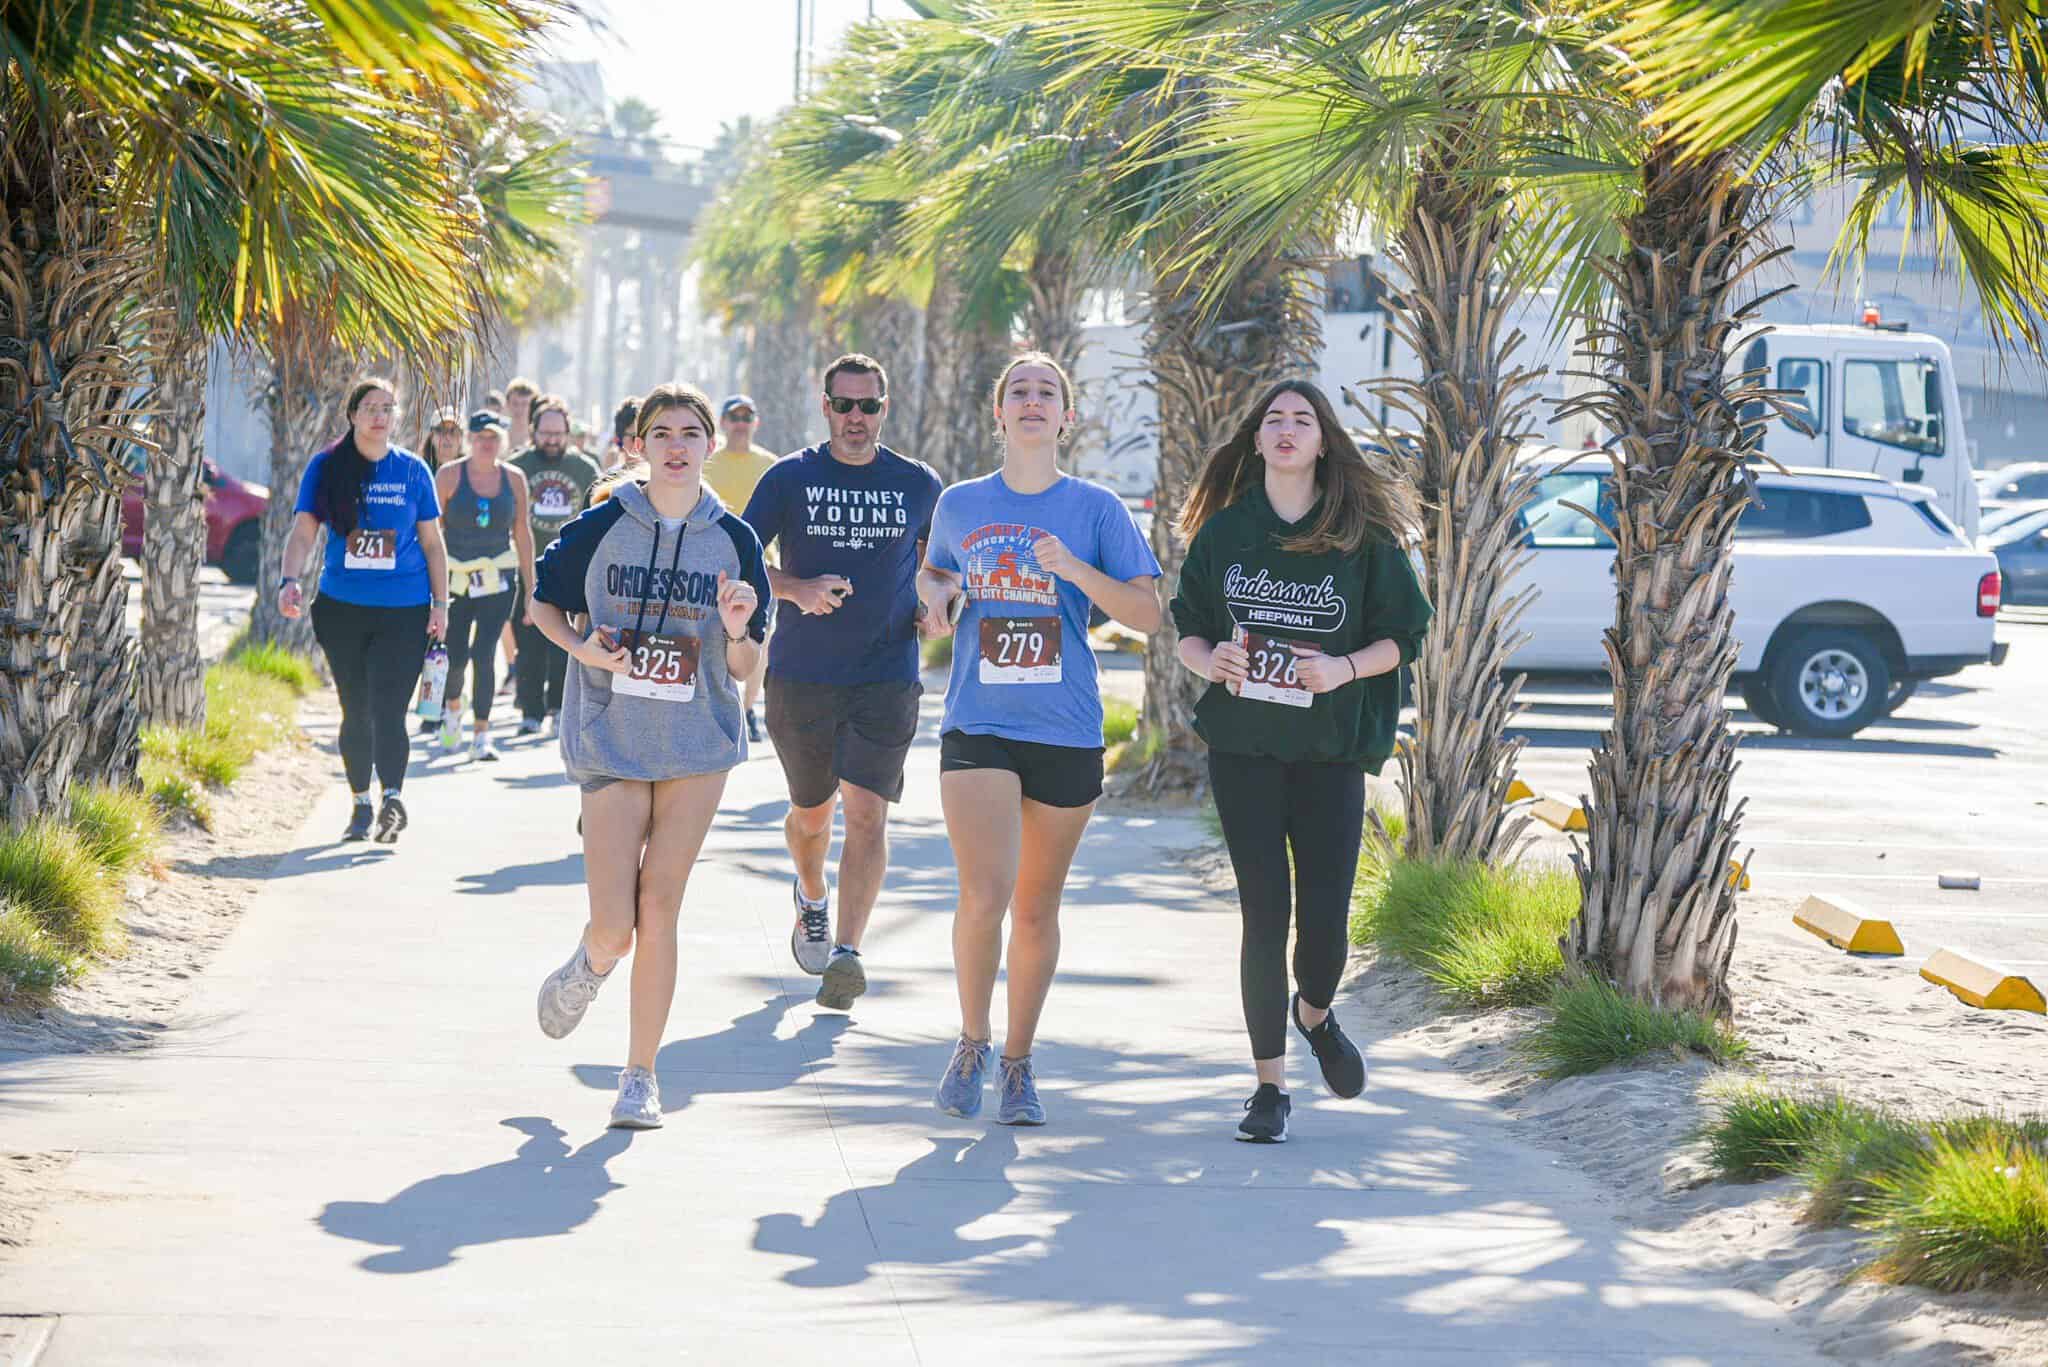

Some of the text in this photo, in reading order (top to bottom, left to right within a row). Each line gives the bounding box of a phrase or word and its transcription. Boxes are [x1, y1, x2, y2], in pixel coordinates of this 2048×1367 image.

[806, 486, 905, 506] WHITNEY
[806, 505, 907, 524] YOUNG
[807, 525, 906, 538] CROSS COUNTRY
[961, 523, 1026, 552] WHITNEY
[356, 537, 384, 557] 241
[607, 563, 718, 608] ONDESSON
[1224, 563, 1334, 607] Ondessonk
[981, 589, 1001, 600] CITY
[1004, 589, 1057, 606] CHAMPIONS
[1248, 609, 1314, 626] HEEPWAH
[997, 632, 1043, 664] 279
[633, 646, 682, 681] 325
[1251, 650, 1298, 685] 326
